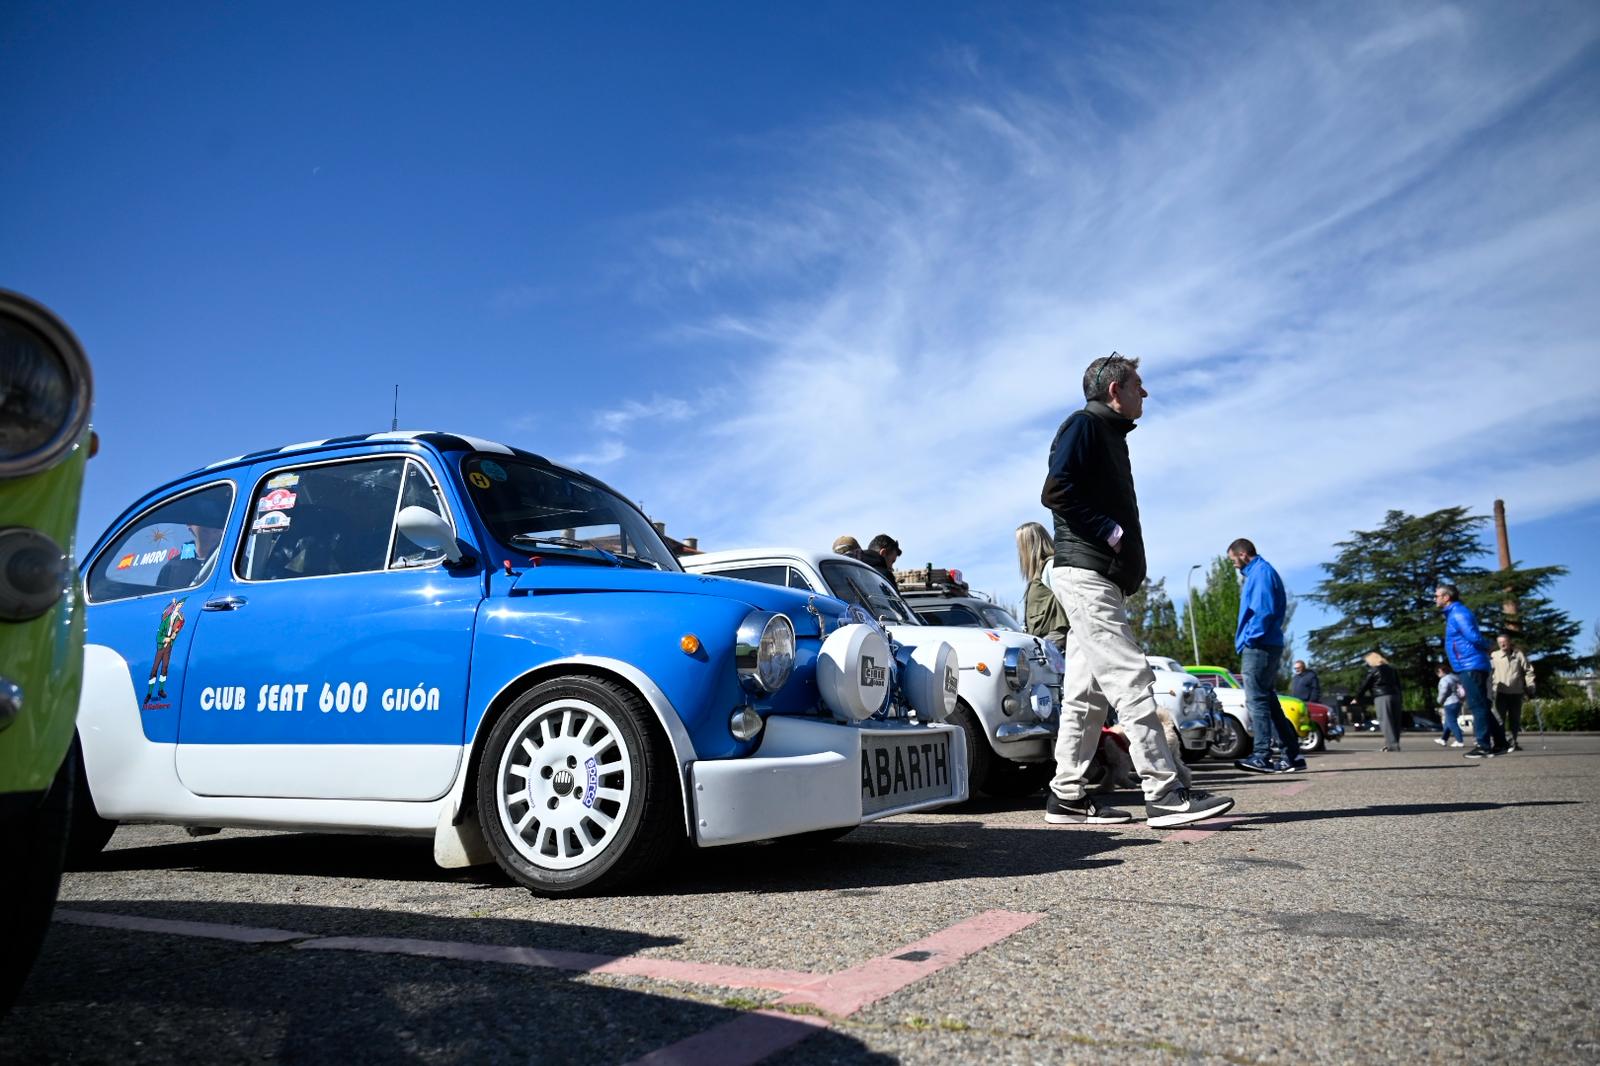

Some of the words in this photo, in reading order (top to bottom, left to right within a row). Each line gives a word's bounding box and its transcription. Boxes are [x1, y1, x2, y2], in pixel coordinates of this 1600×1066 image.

[472, 474, 487, 486] H
[140, 549, 168, 566] MORO
[200, 686, 246, 711] CLUB
[257, 684, 309, 712] SEAT
[319, 681, 368, 713] 600
[381, 682, 440, 712] GIJÓN
[585, 759, 598, 807] sparco
[861, 742, 948, 799] ABARTH
